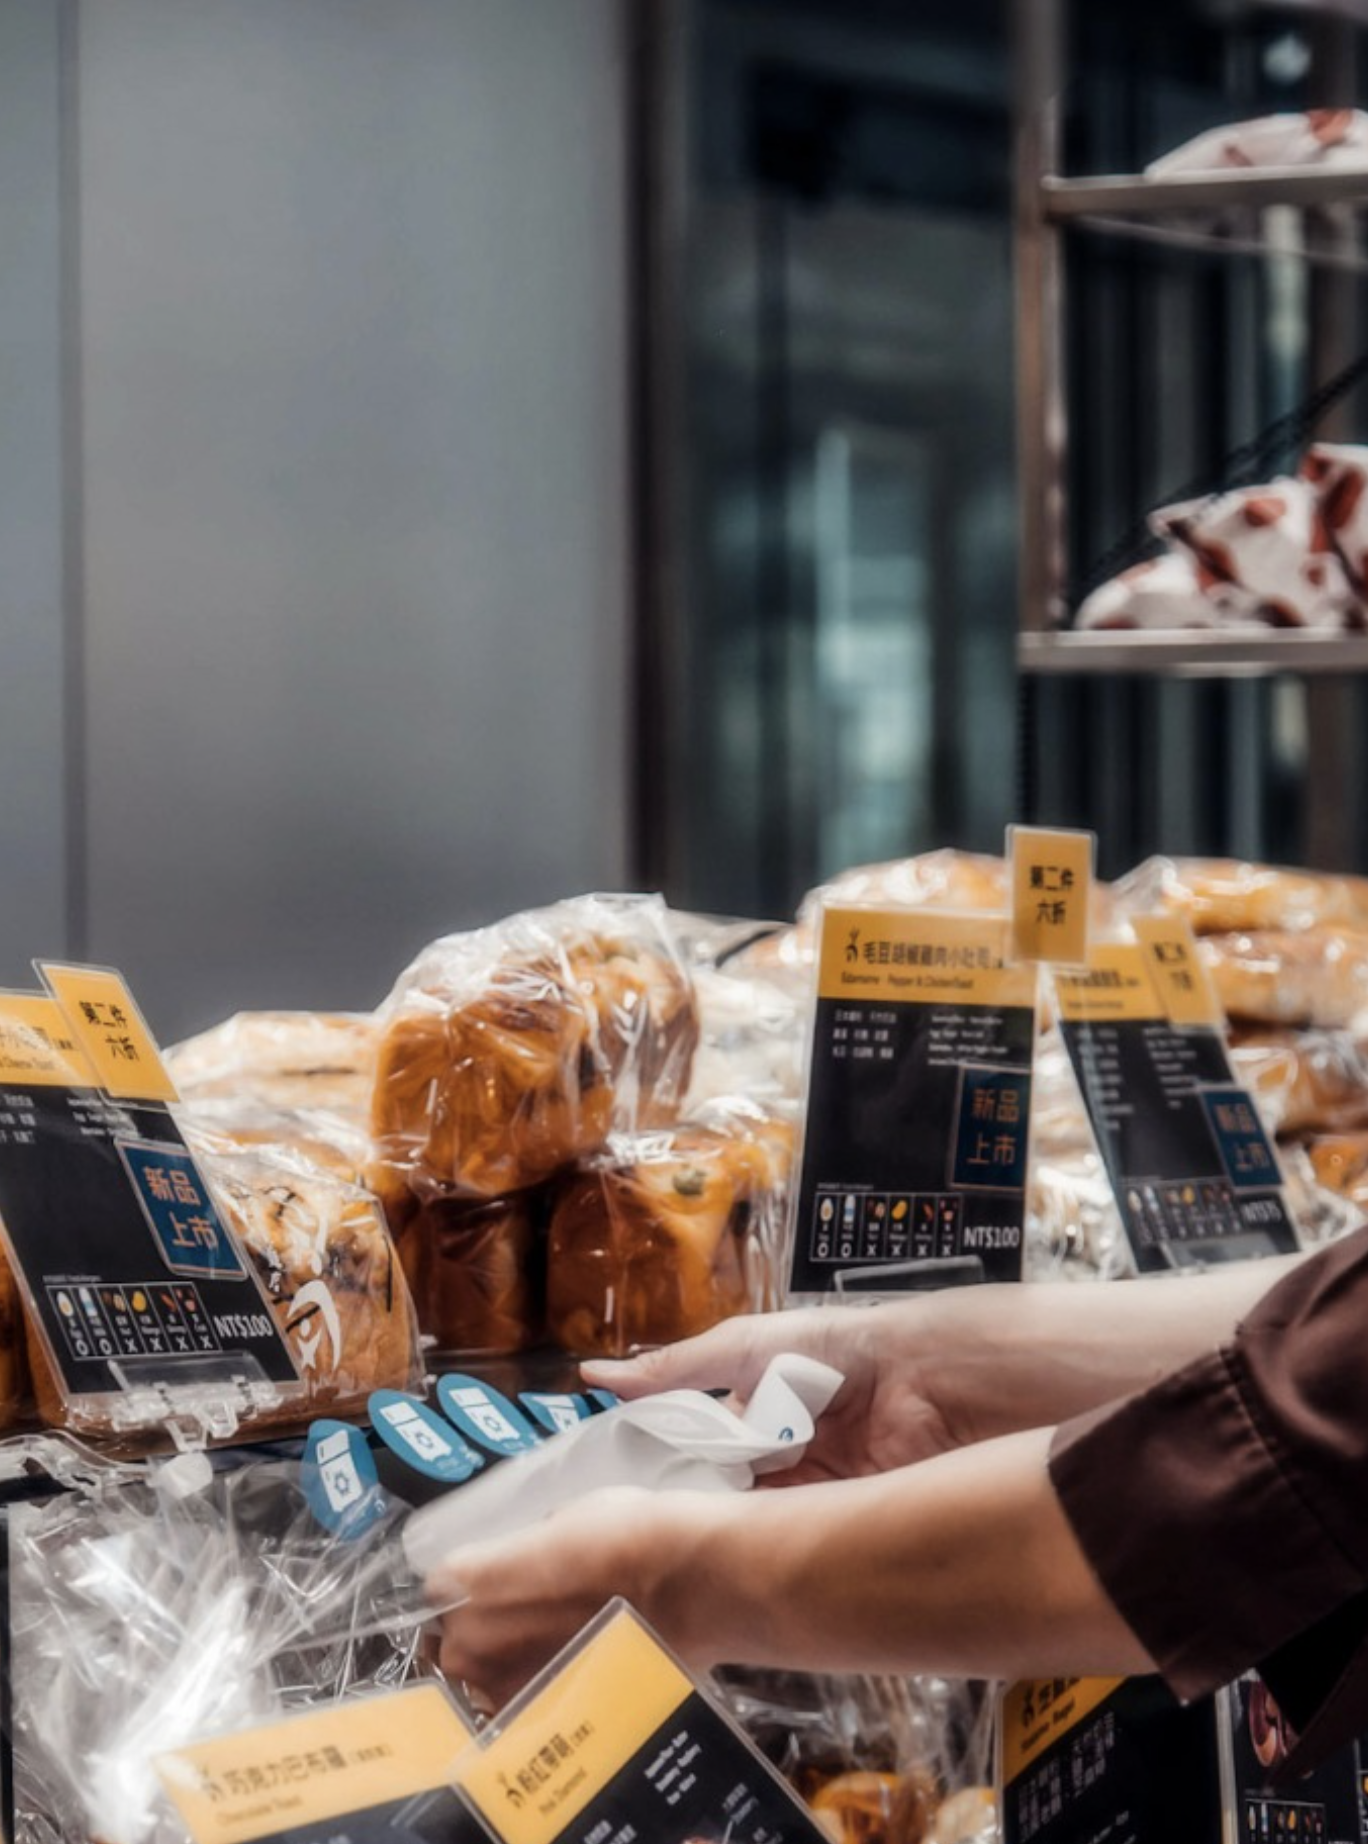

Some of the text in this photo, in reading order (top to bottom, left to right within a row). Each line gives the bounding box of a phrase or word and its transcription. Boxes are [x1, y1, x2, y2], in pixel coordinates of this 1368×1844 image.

[1036, 898, 1066, 924] 六折
[79, 1001, 127, 1028] 第二件
[105, 1034, 140, 1061] 六折
[971, 1088, 1019, 1122] 新品
[966, 1131, 1016, 1166] 上市
[143, 1166, 201, 1206] 新品
[168, 1211, 218, 1251] 上市
[964, 1226, 1020, 1249] NT$100
[213, 1313, 274, 1339] NT$100
